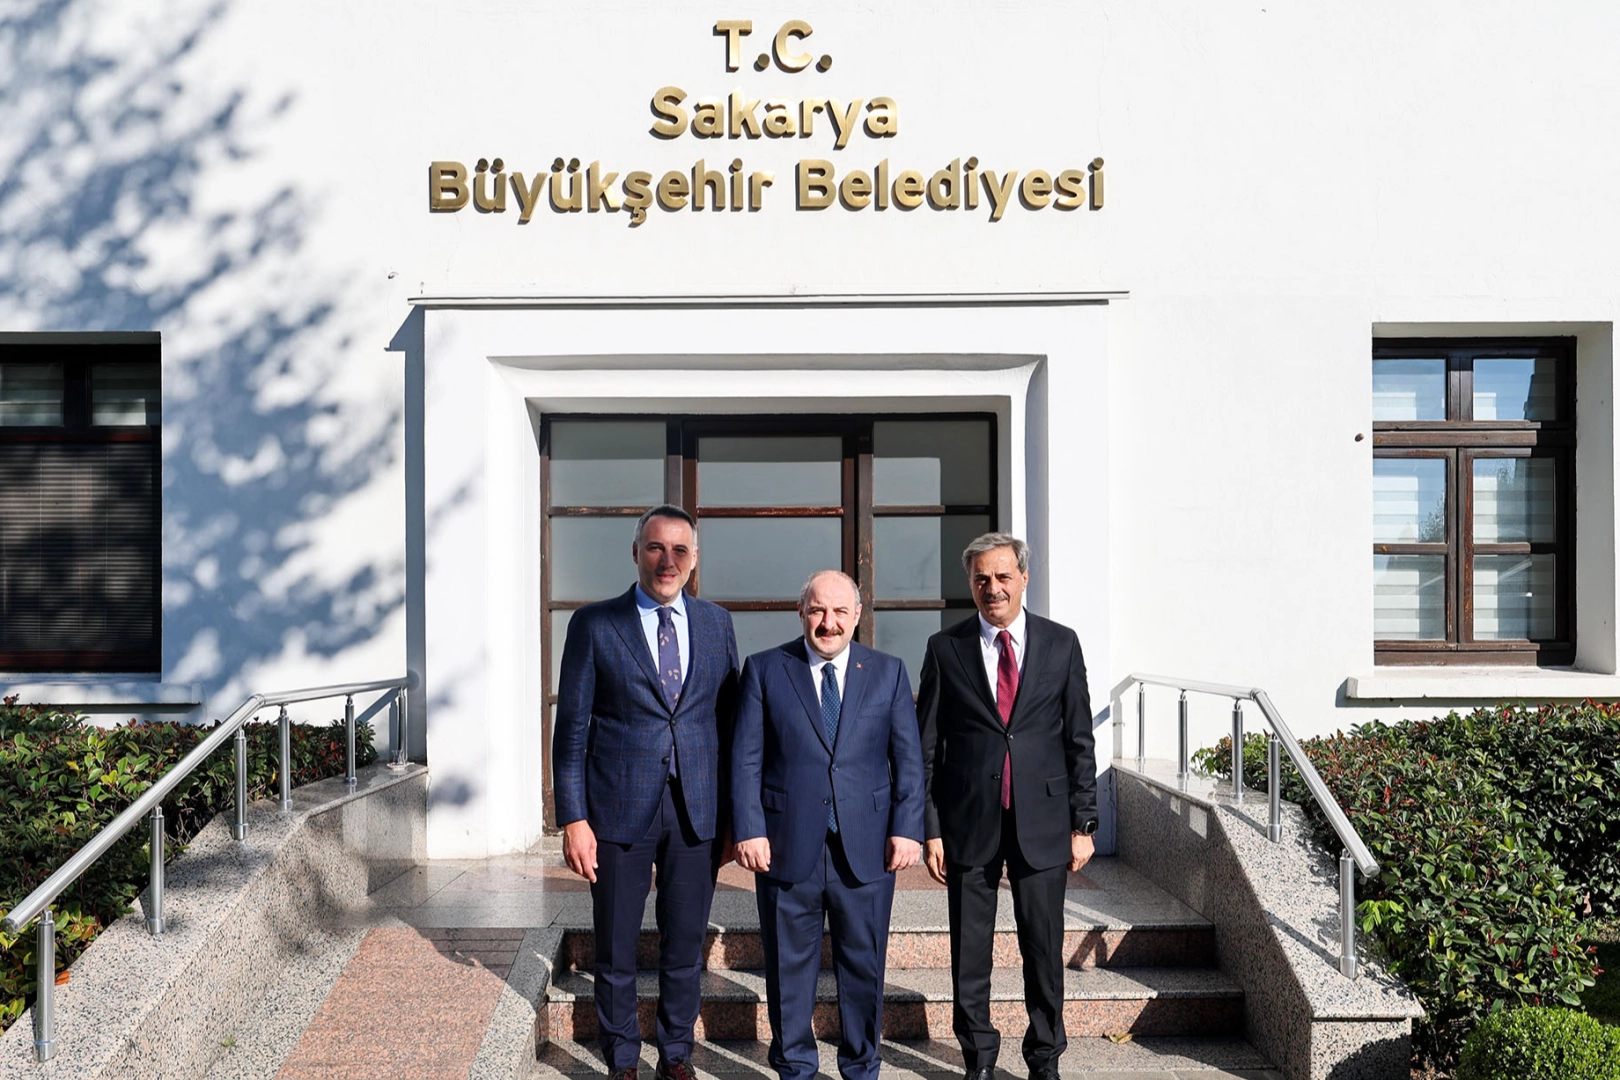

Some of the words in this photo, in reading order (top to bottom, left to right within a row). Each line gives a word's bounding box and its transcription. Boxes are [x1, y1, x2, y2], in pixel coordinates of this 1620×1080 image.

[714, 20, 832, 73] T.C.
[650, 86, 897, 150] Sakarya
[429, 157, 774, 226] Büyükşehir
[796, 156, 1105, 221] Belediyesi
